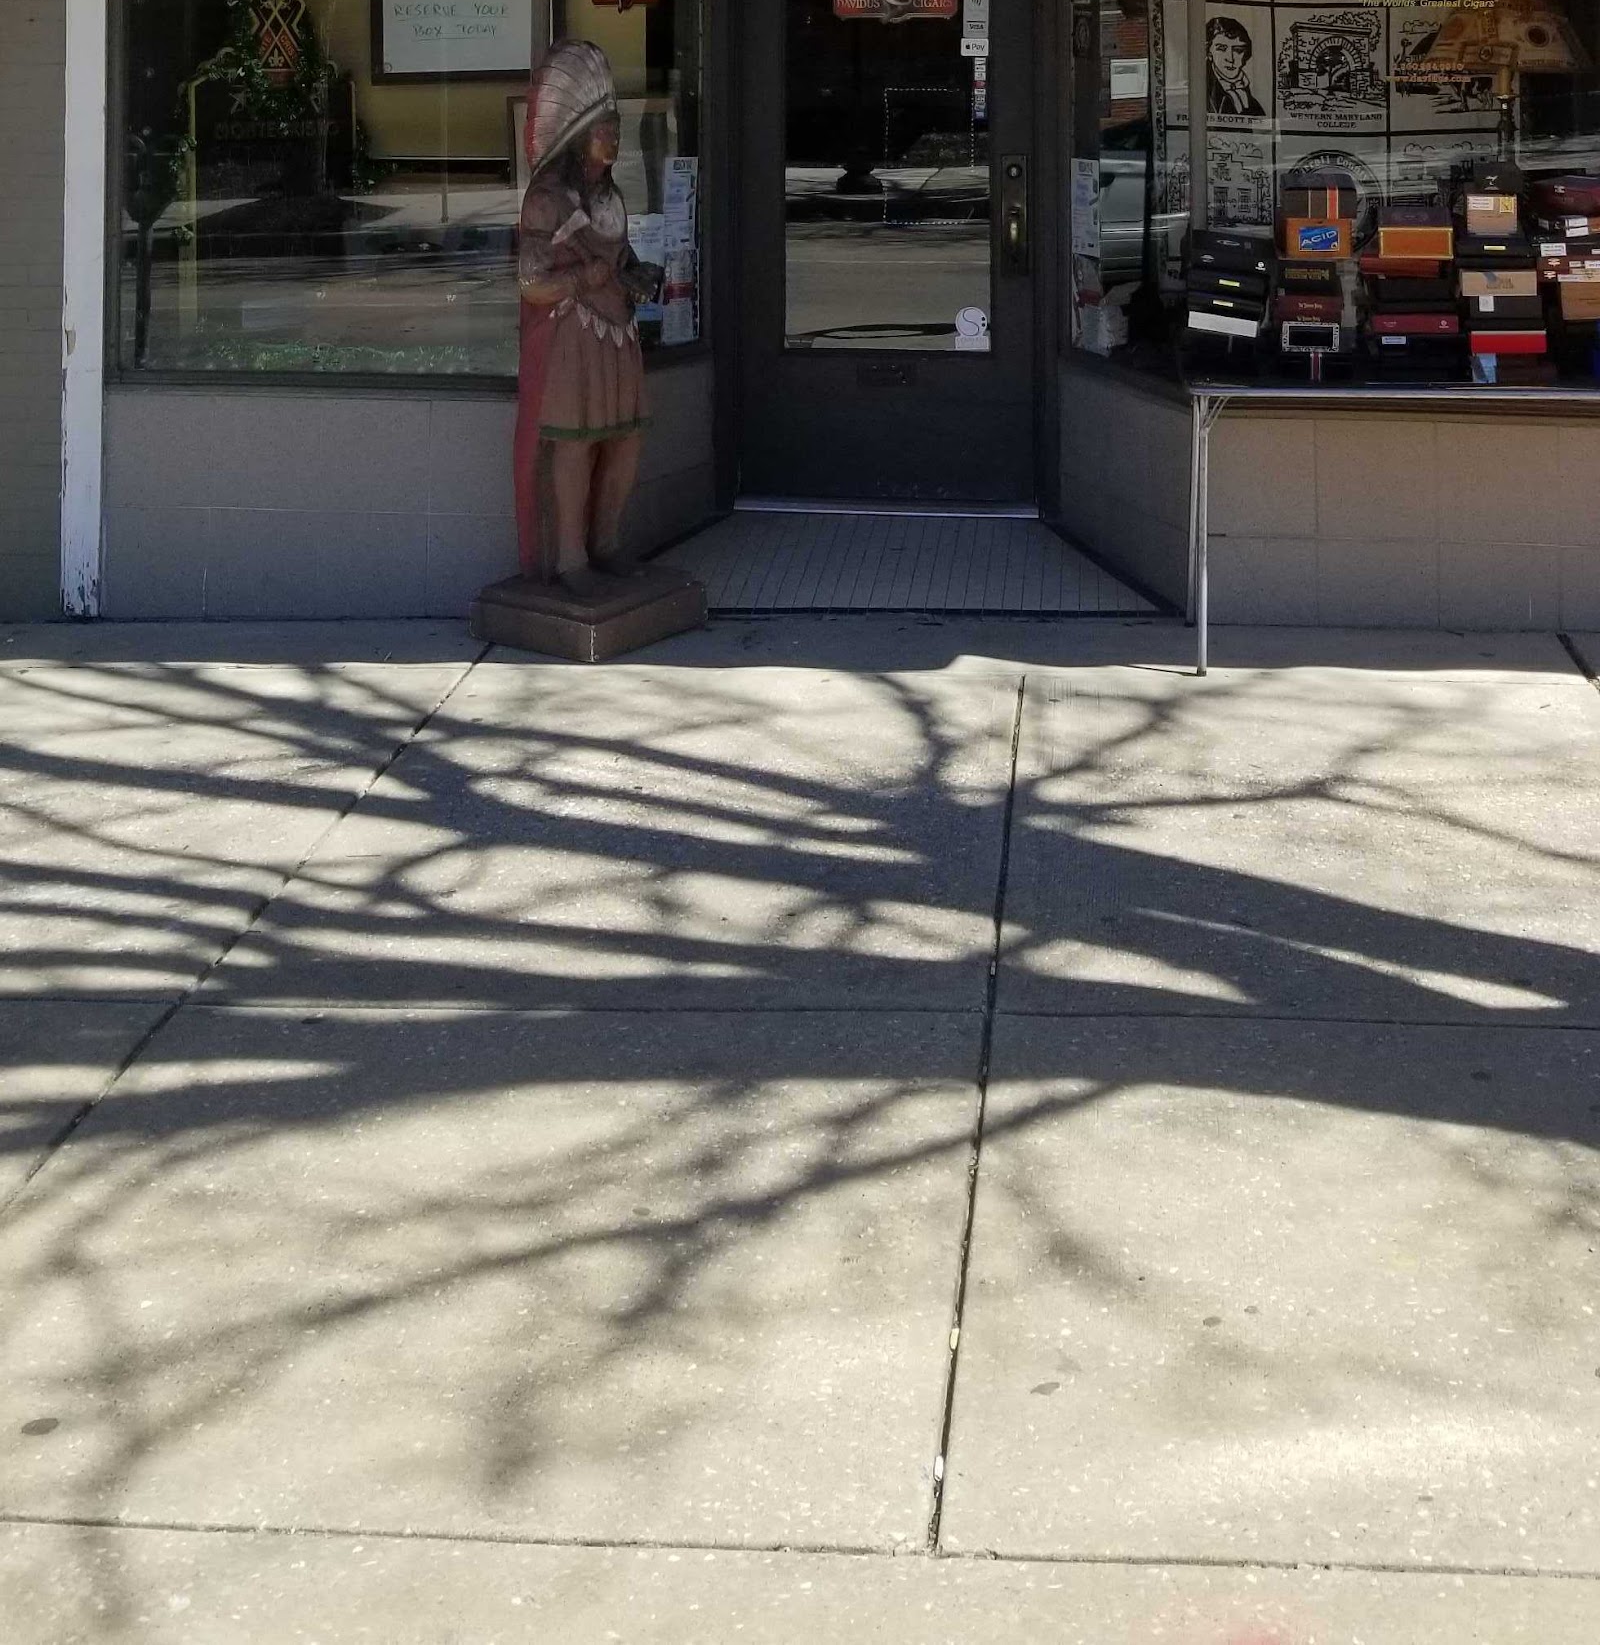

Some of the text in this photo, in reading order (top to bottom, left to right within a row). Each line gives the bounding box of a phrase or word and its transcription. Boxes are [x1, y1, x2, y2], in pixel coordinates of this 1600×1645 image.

[394, 3, 509, 16] RESERVE YOUR
[413, 24, 497, 36] BOX TODAY
[971, 43, 985, 52] Pay
[1301, 230, 1337, 247] ACID
